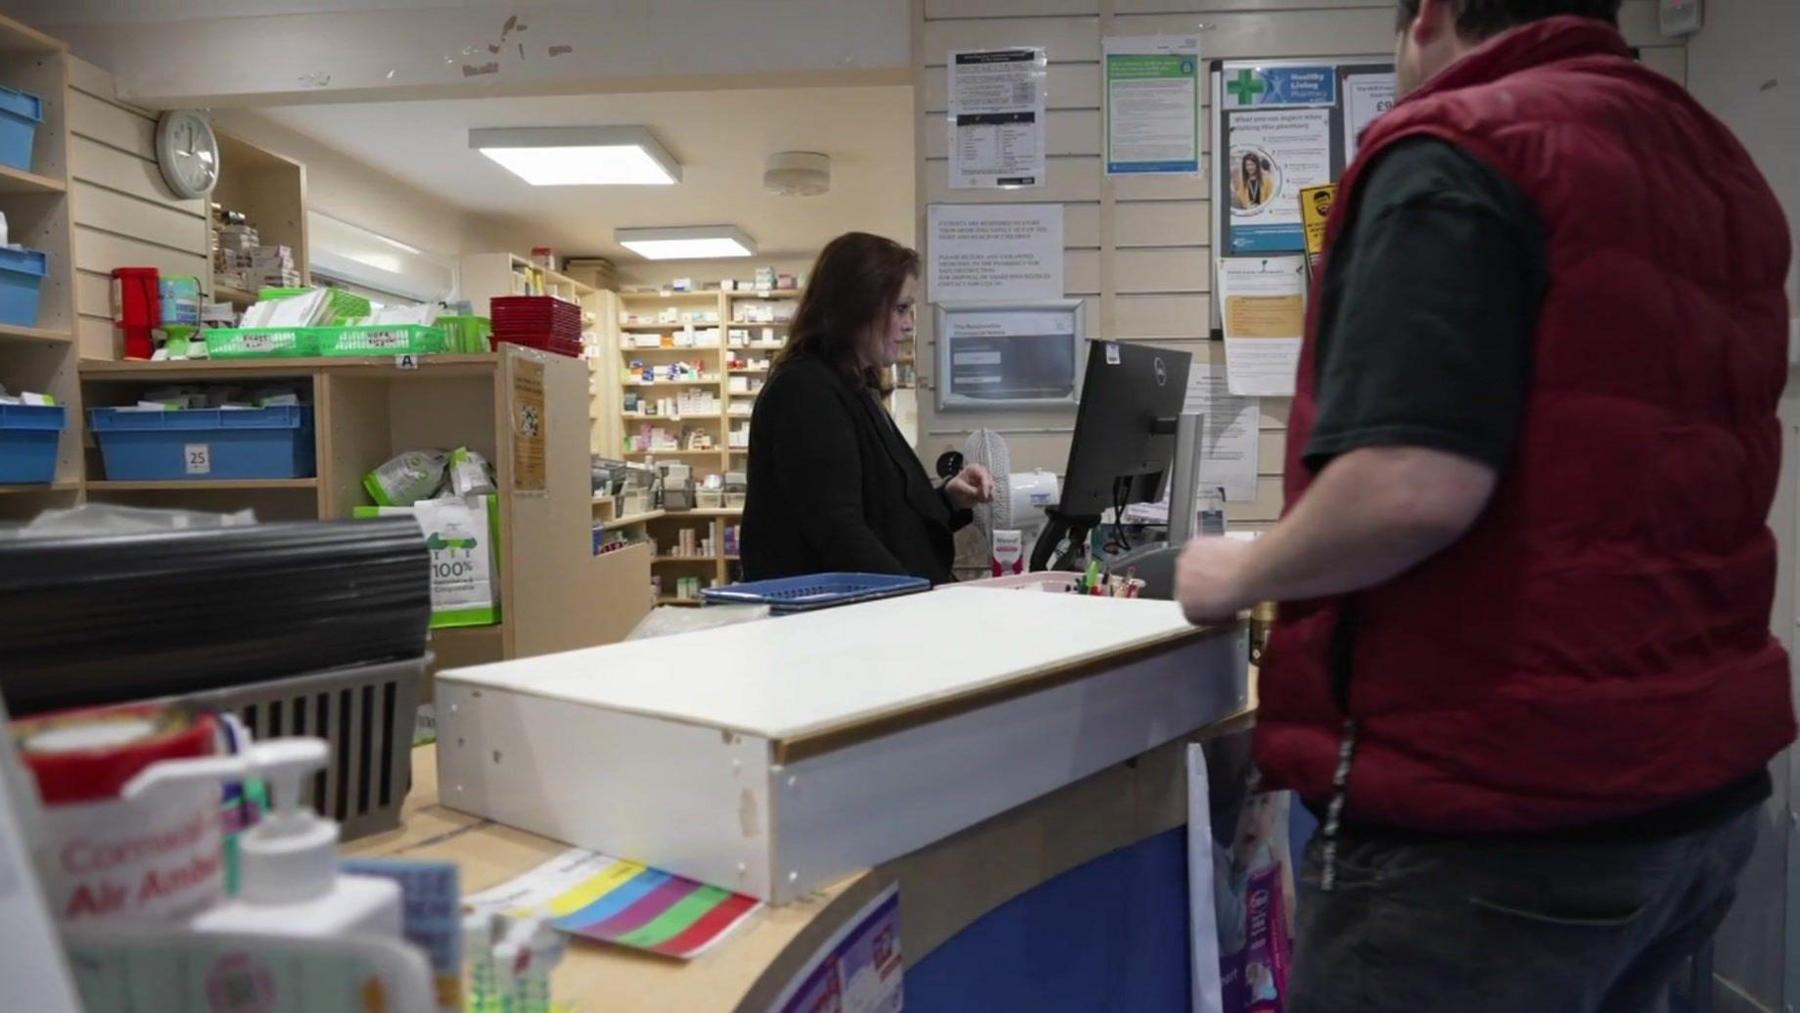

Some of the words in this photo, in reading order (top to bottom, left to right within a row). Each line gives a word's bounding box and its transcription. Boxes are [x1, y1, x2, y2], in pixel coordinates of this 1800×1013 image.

[1290, 73, 1325, 82] Healthy
[402, 355, 413, 367] A
[190, 451, 206, 464] 25
[432, 561, 473, 578] 100%
